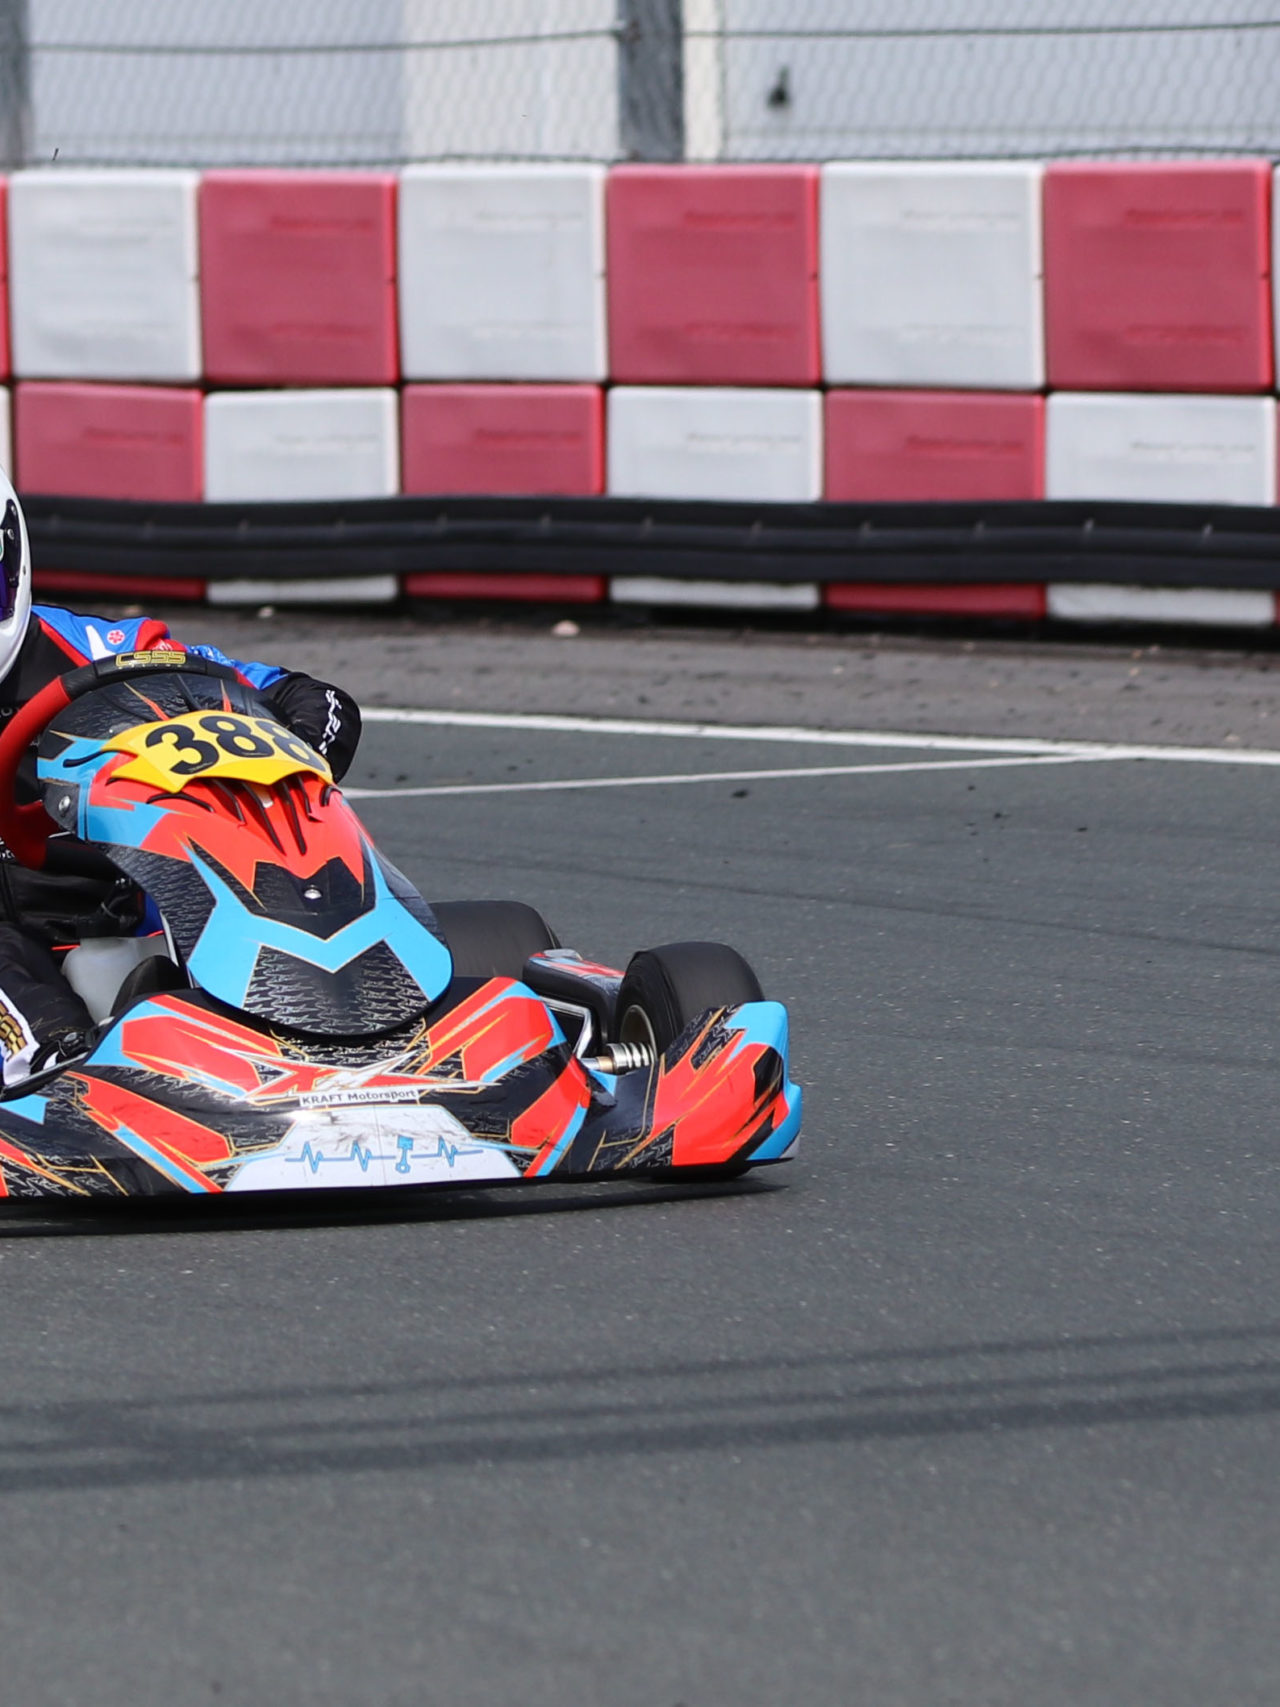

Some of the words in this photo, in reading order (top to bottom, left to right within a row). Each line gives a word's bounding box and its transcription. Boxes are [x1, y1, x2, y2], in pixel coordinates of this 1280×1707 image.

[145, 715, 327, 775] 388
[302, 1094, 343, 1106] KRAFT
[347, 1088, 417, 1104] Motorsport
